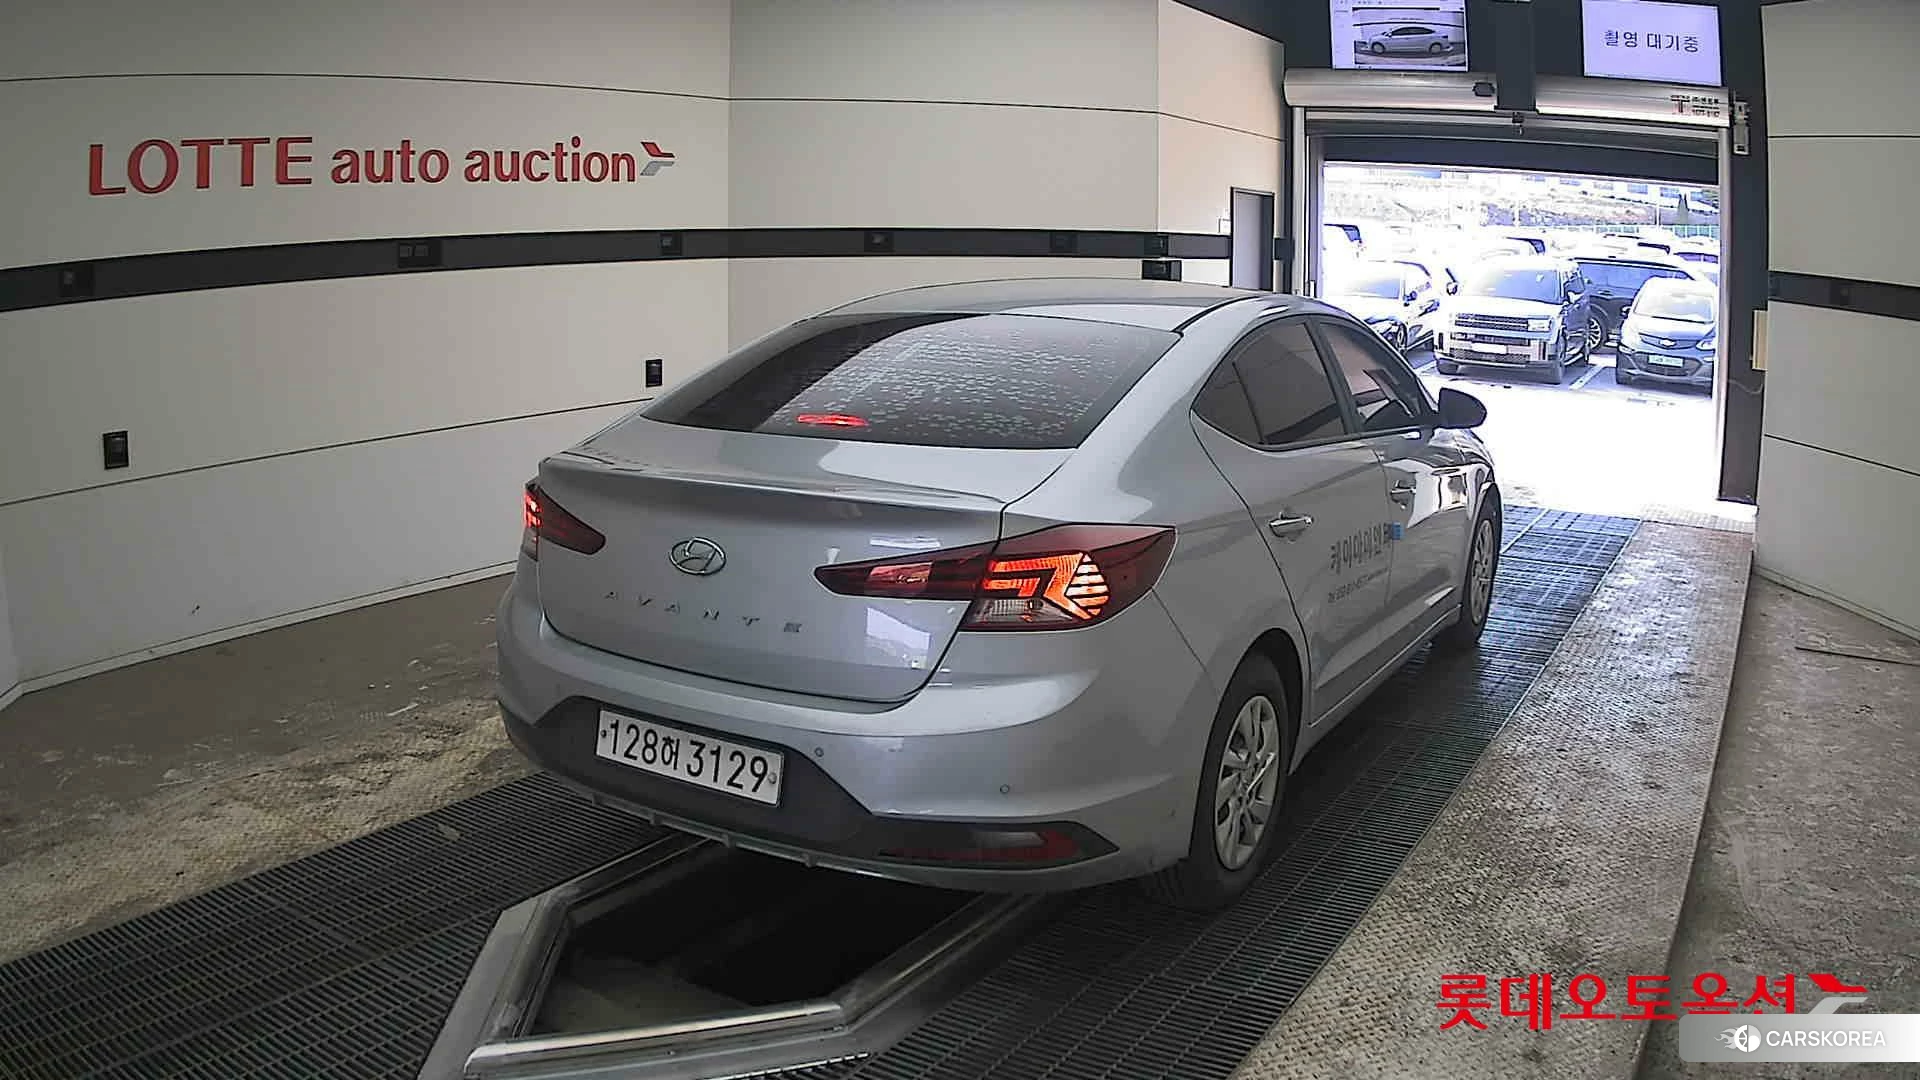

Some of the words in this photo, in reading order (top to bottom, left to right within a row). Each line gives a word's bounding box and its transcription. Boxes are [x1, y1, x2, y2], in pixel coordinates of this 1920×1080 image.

[1646, 31, 1698, 51] 대기중
[89, 136, 313, 197] LOTTE
[330, 138, 450, 185] auto
[463, 136, 637, 184] auction
[605, 590, 803, 633] AVANTE
